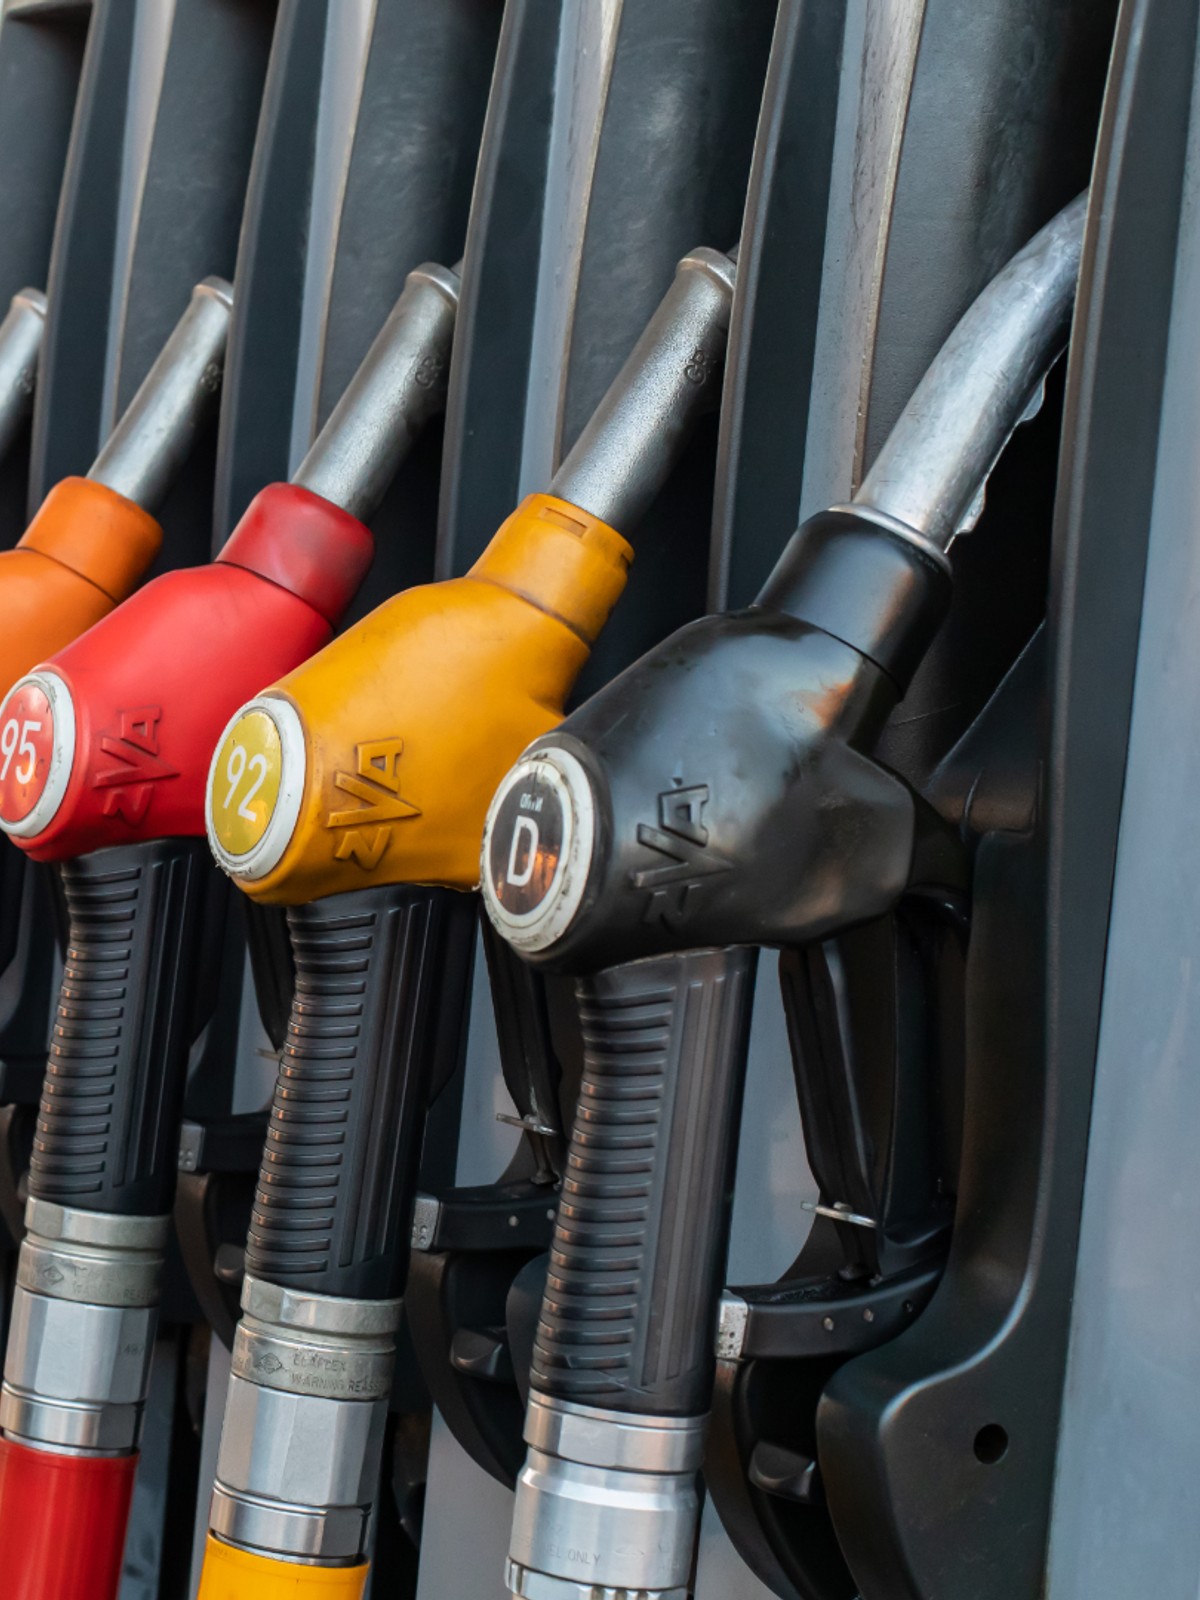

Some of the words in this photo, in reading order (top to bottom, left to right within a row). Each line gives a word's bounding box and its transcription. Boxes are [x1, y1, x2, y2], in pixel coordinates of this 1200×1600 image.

[0, 718, 43, 785] 95
[222, 744, 268, 823] 92
[506, 814, 540, 888] D
